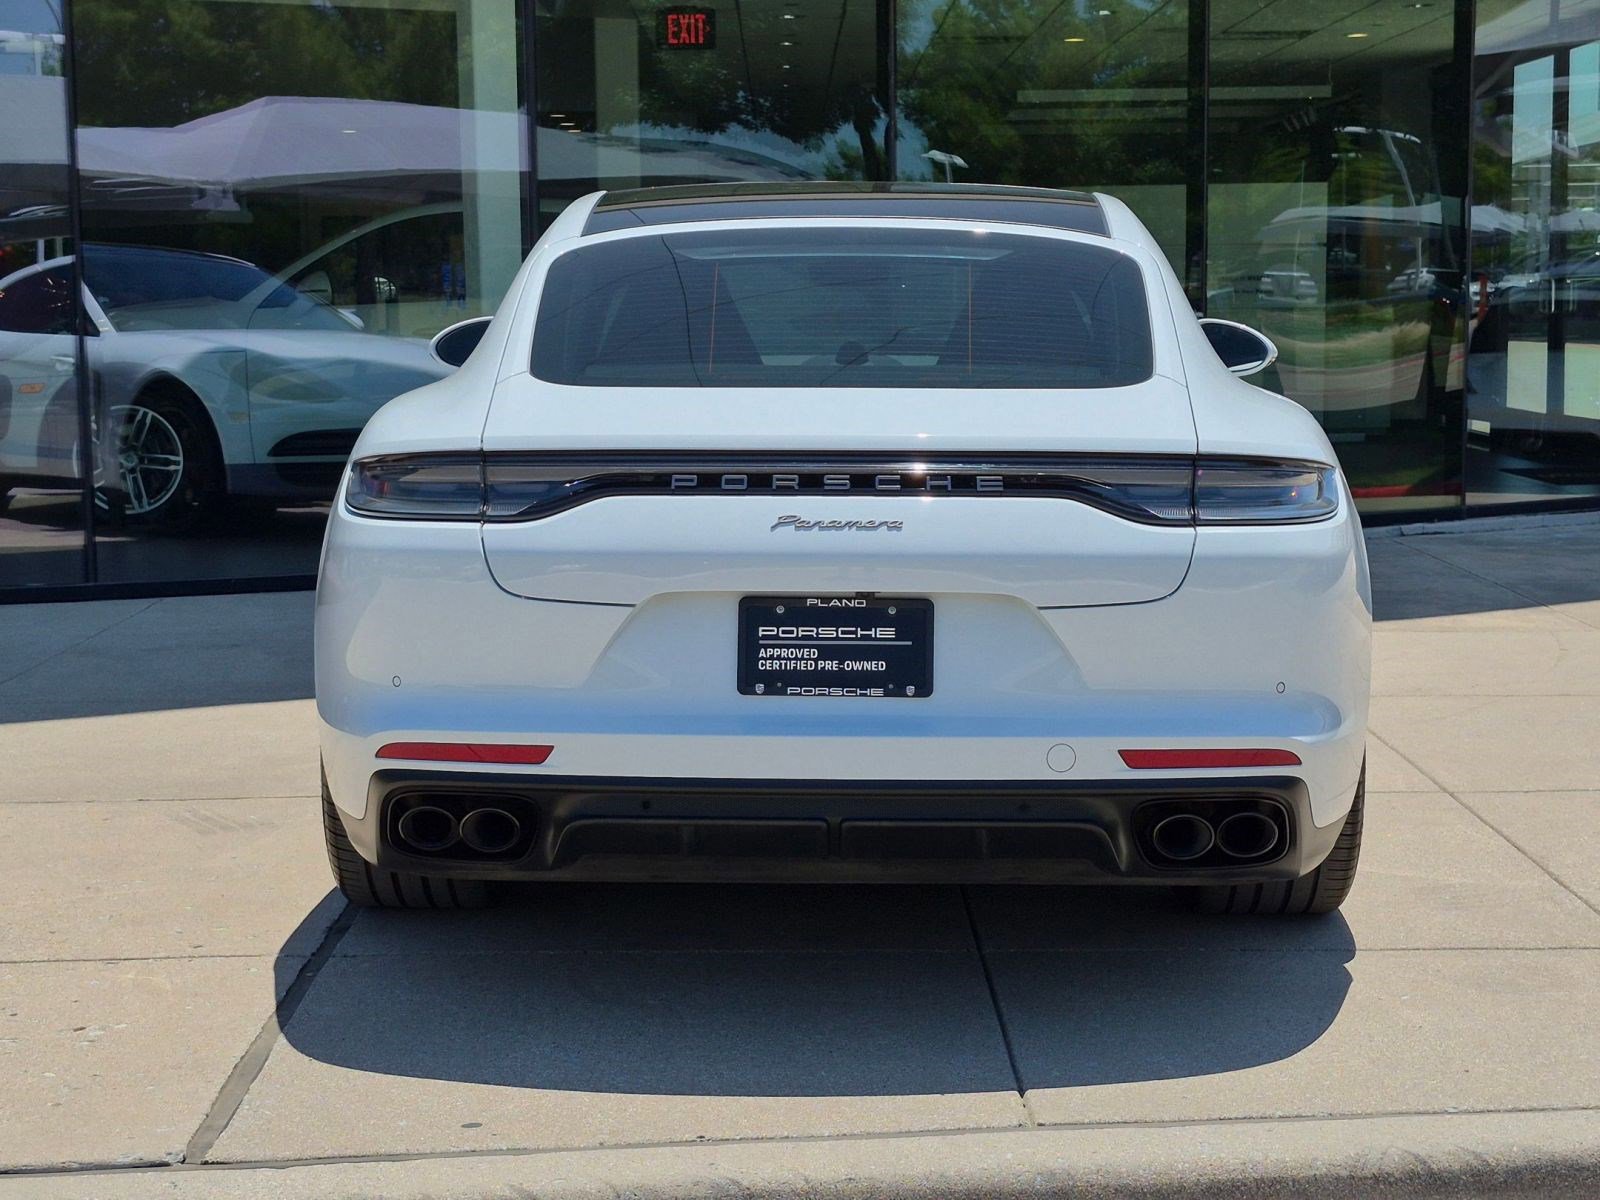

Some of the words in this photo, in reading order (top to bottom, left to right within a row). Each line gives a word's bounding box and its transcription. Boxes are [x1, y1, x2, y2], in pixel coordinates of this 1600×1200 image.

[667, 14, 705, 44] EXIT
[671, 474, 1004, 491] PORSCHE
[770, 515, 904, 532] Panamera
[806, 598, 867, 608] PLANO
[758, 626, 896, 638] PORSCHE
[758, 648, 819, 659] APPROVED
[758, 660, 815, 671] CERTIFIED
[817, 660, 887, 671] PRE-OWNED
[787, 687, 885, 697] PORSCHE
